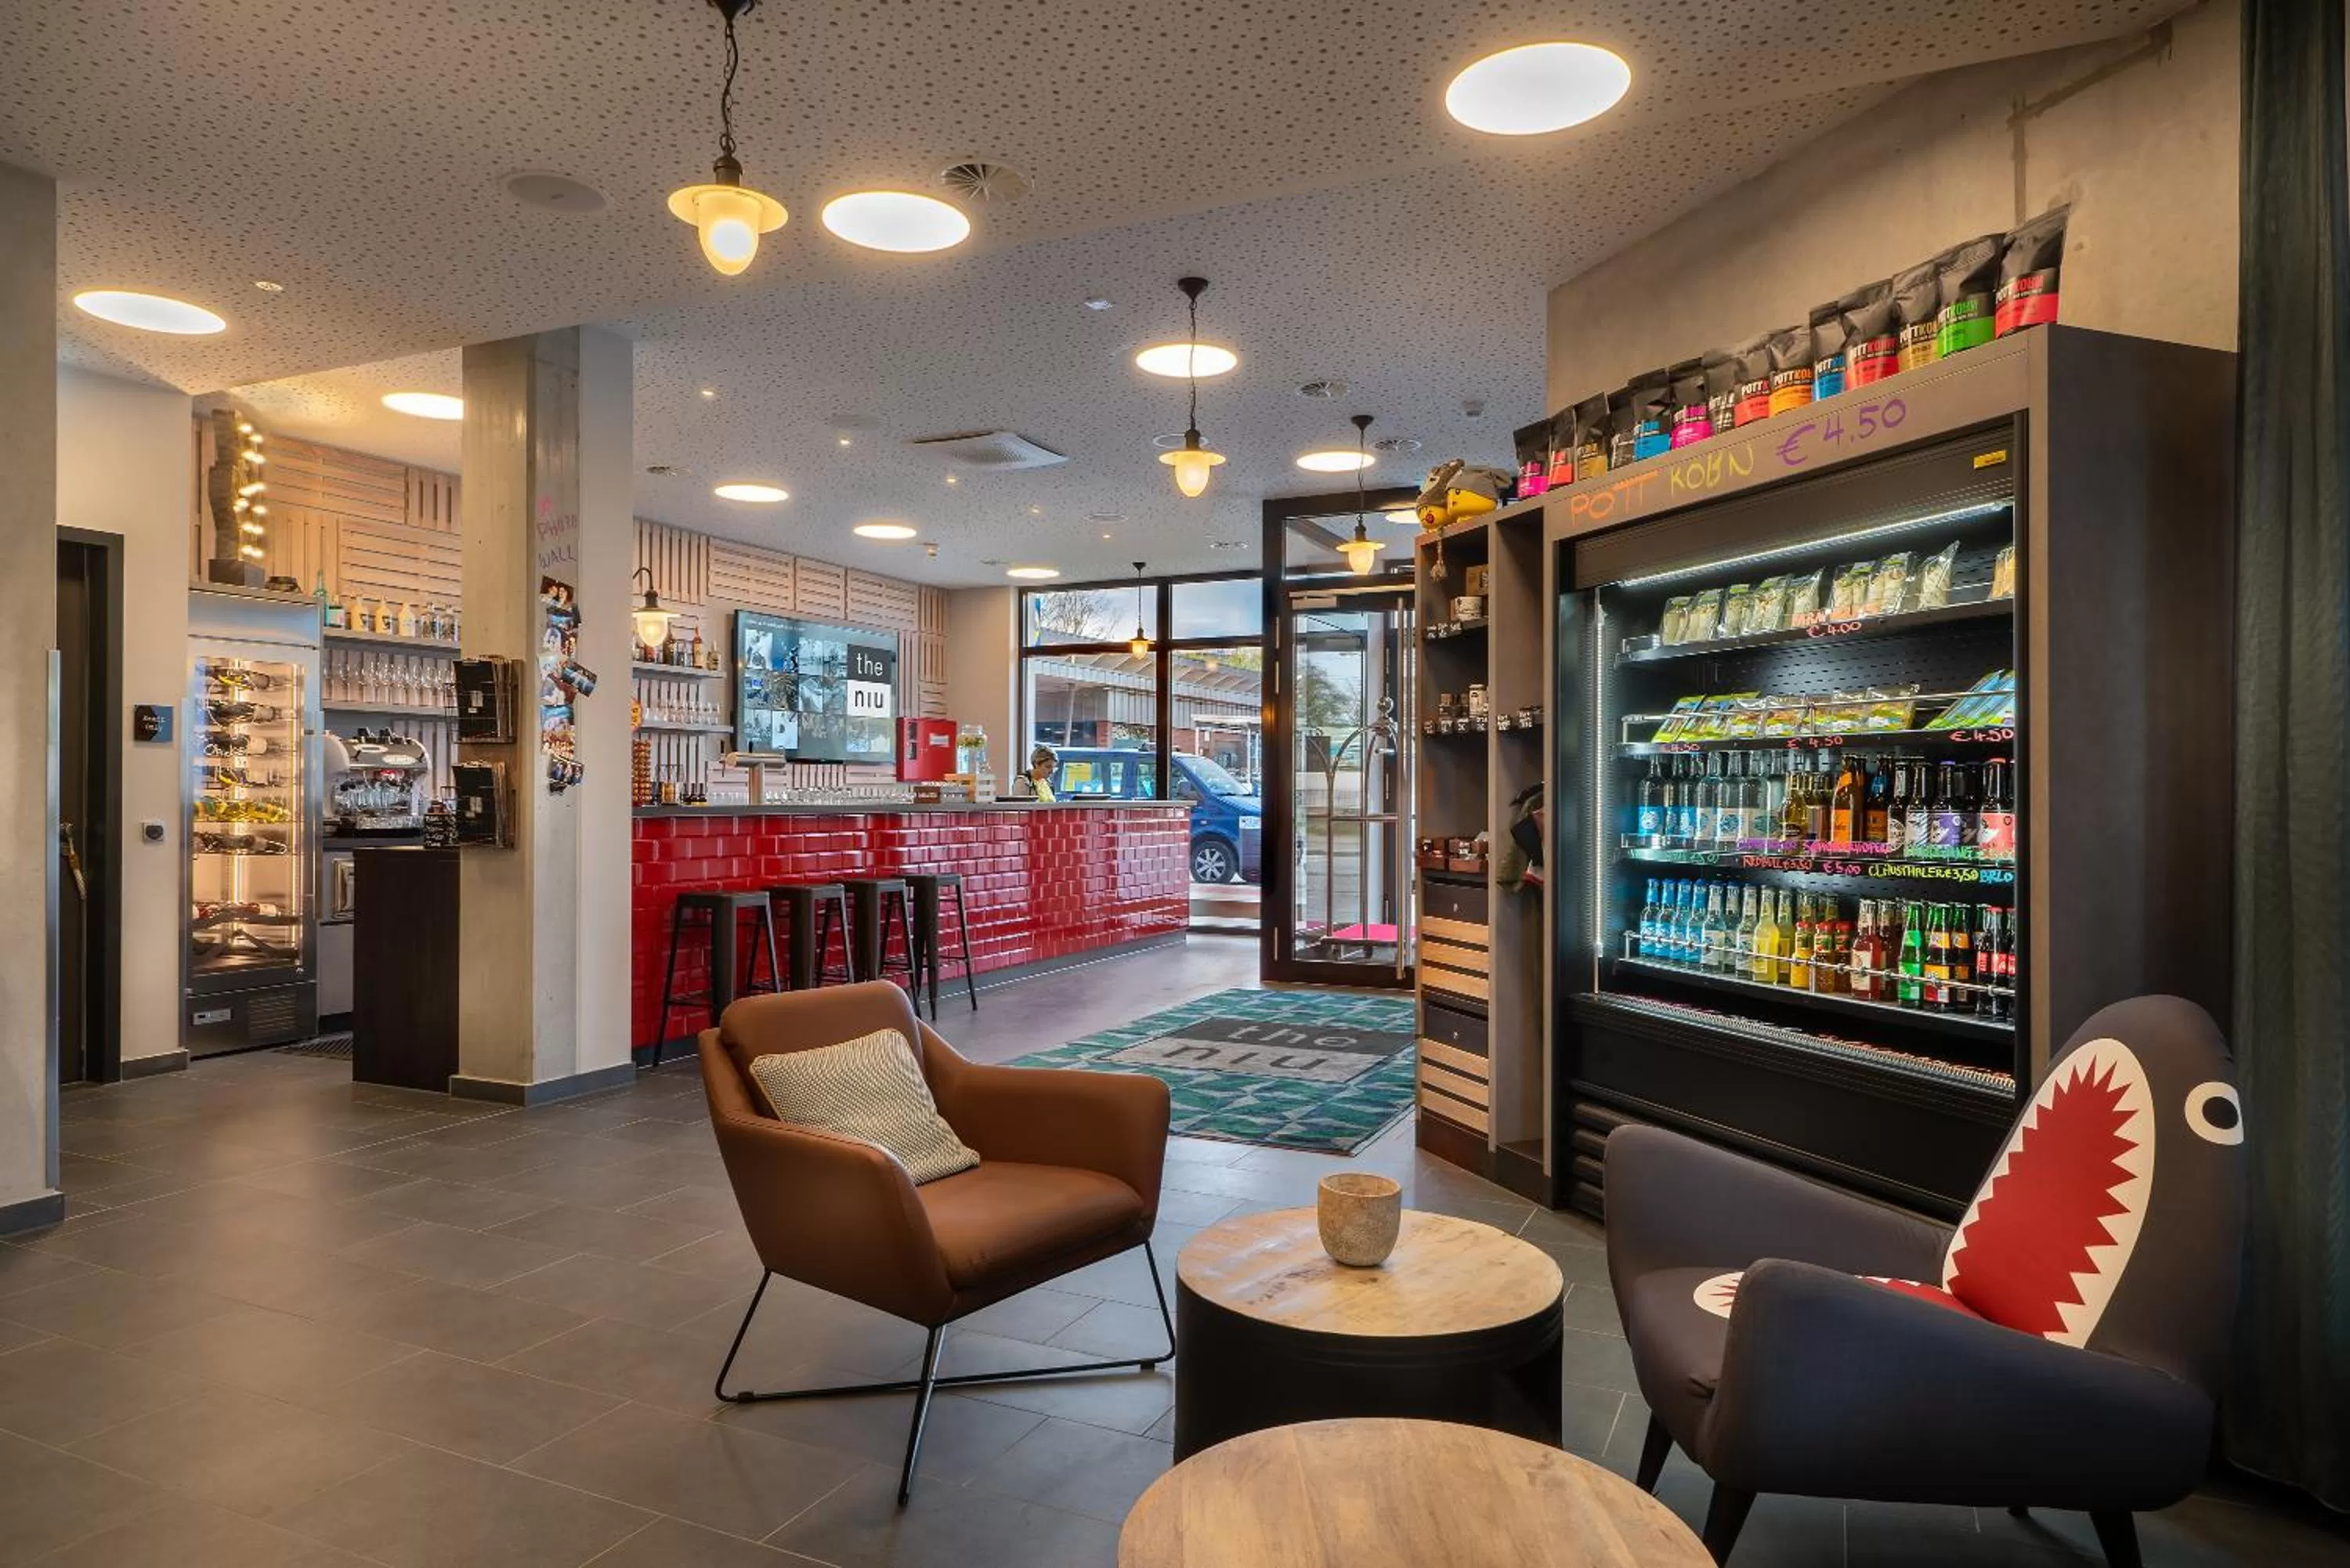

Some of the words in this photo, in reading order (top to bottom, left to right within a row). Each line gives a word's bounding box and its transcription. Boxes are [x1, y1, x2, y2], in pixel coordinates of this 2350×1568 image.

[1570, 469, 1659, 528] POTT
[856, 652, 884, 677] the
[854, 689, 884, 709] niu
[1228, 1025, 1358, 1048] the
[1162, 1046, 1329, 1071] niu
